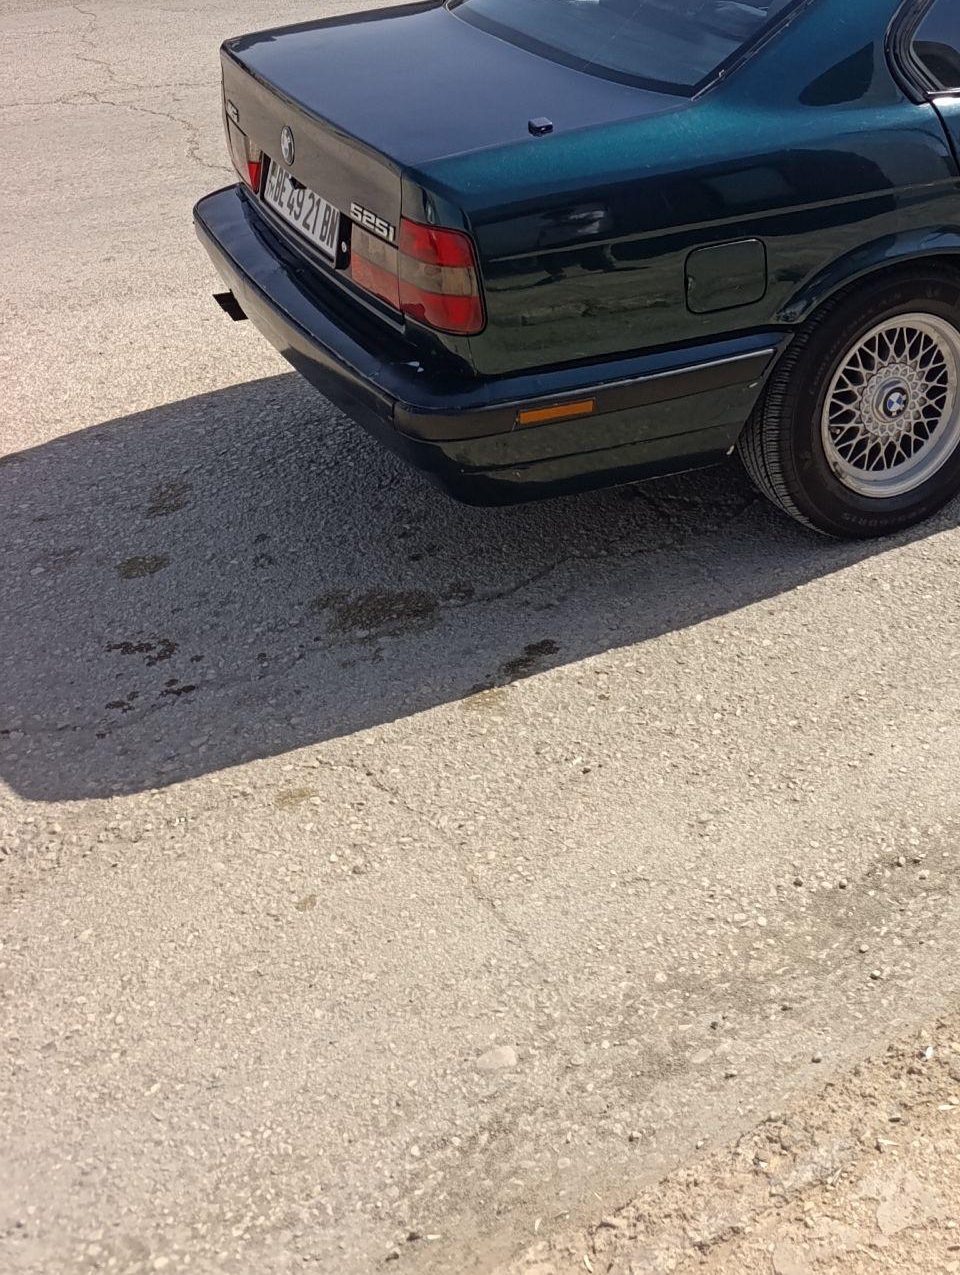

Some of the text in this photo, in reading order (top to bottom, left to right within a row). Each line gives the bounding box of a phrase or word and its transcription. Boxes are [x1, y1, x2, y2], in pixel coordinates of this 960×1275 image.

[286, 187, 305, 221] 49
[302, 193, 321, 235] 21
[319, 204, 340, 249] BN
